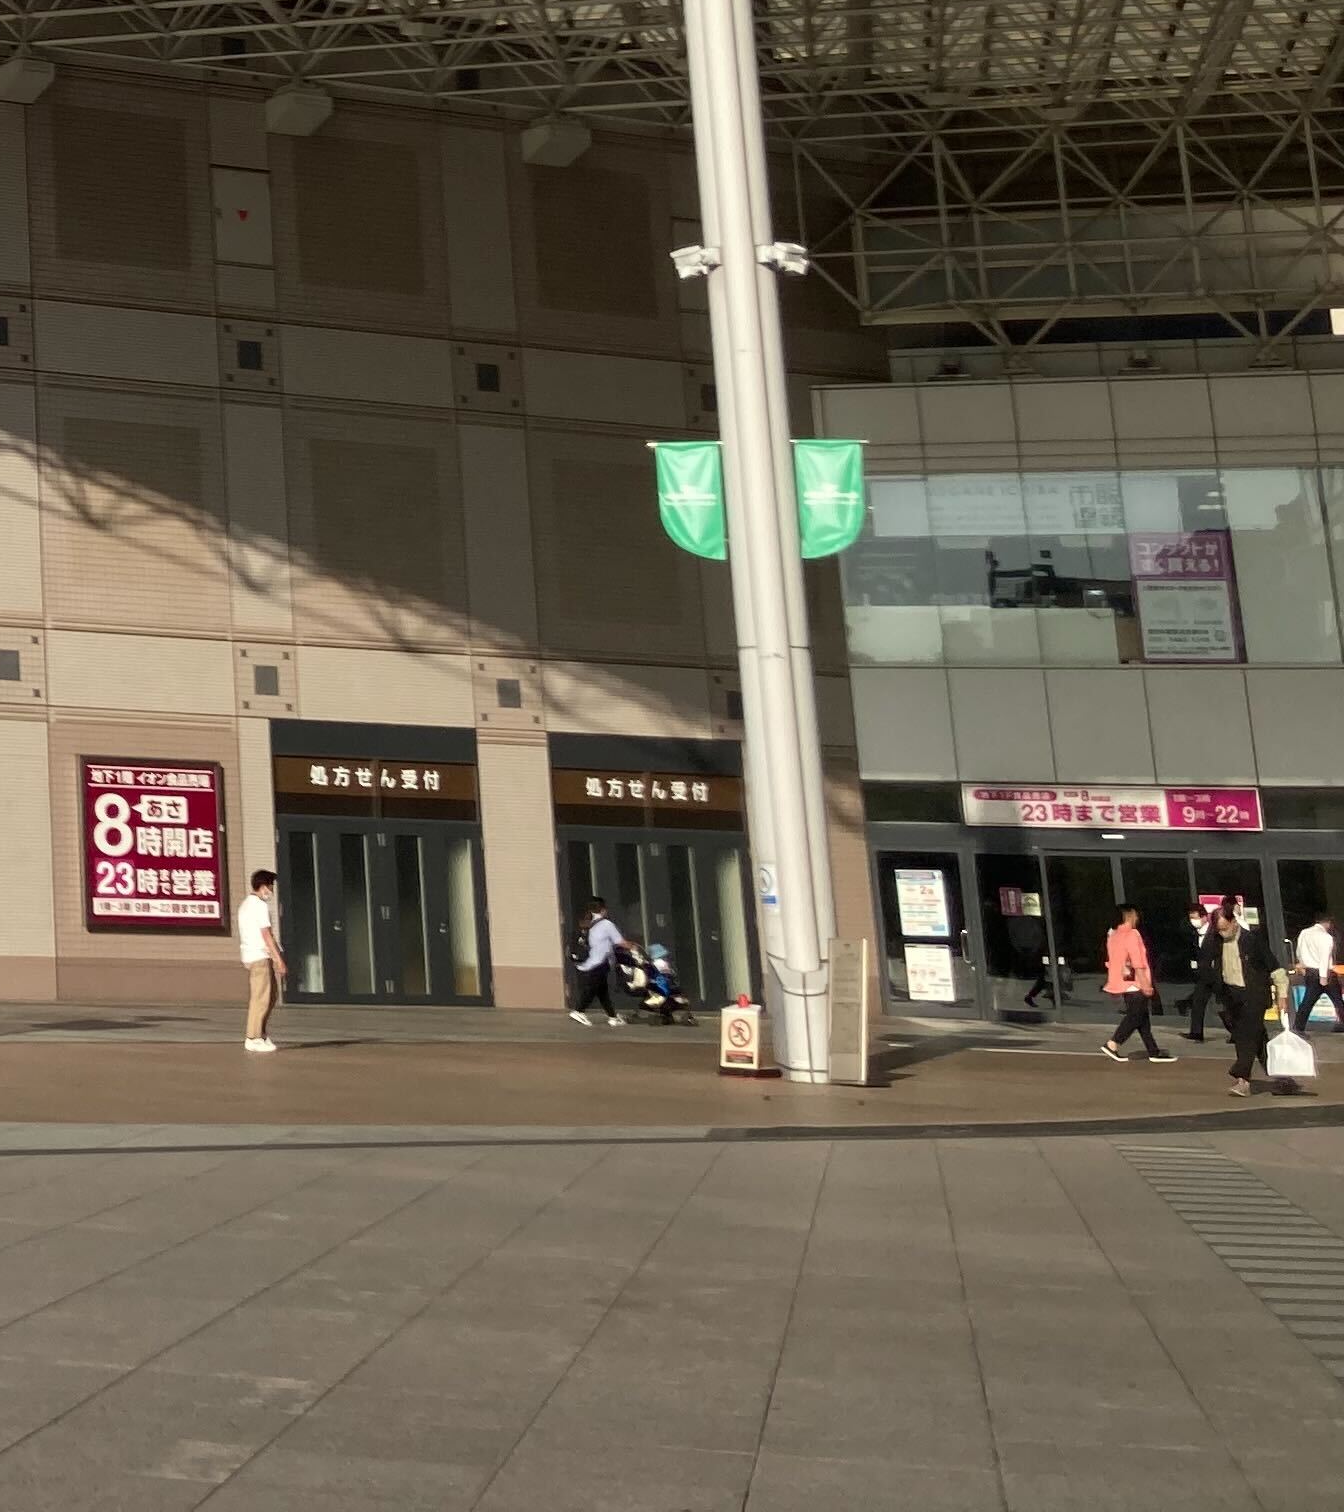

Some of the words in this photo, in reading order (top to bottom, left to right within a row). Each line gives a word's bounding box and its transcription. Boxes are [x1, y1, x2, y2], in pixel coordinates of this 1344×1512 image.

[309, 765, 441, 791] 処方せん受付
[585, 777, 711, 803] 処方せん受付
[146, 799, 183, 819] あさ
[1021, 803, 1161, 824] 23時まで営業
[96, 861, 216, 896] 23時まで営業
